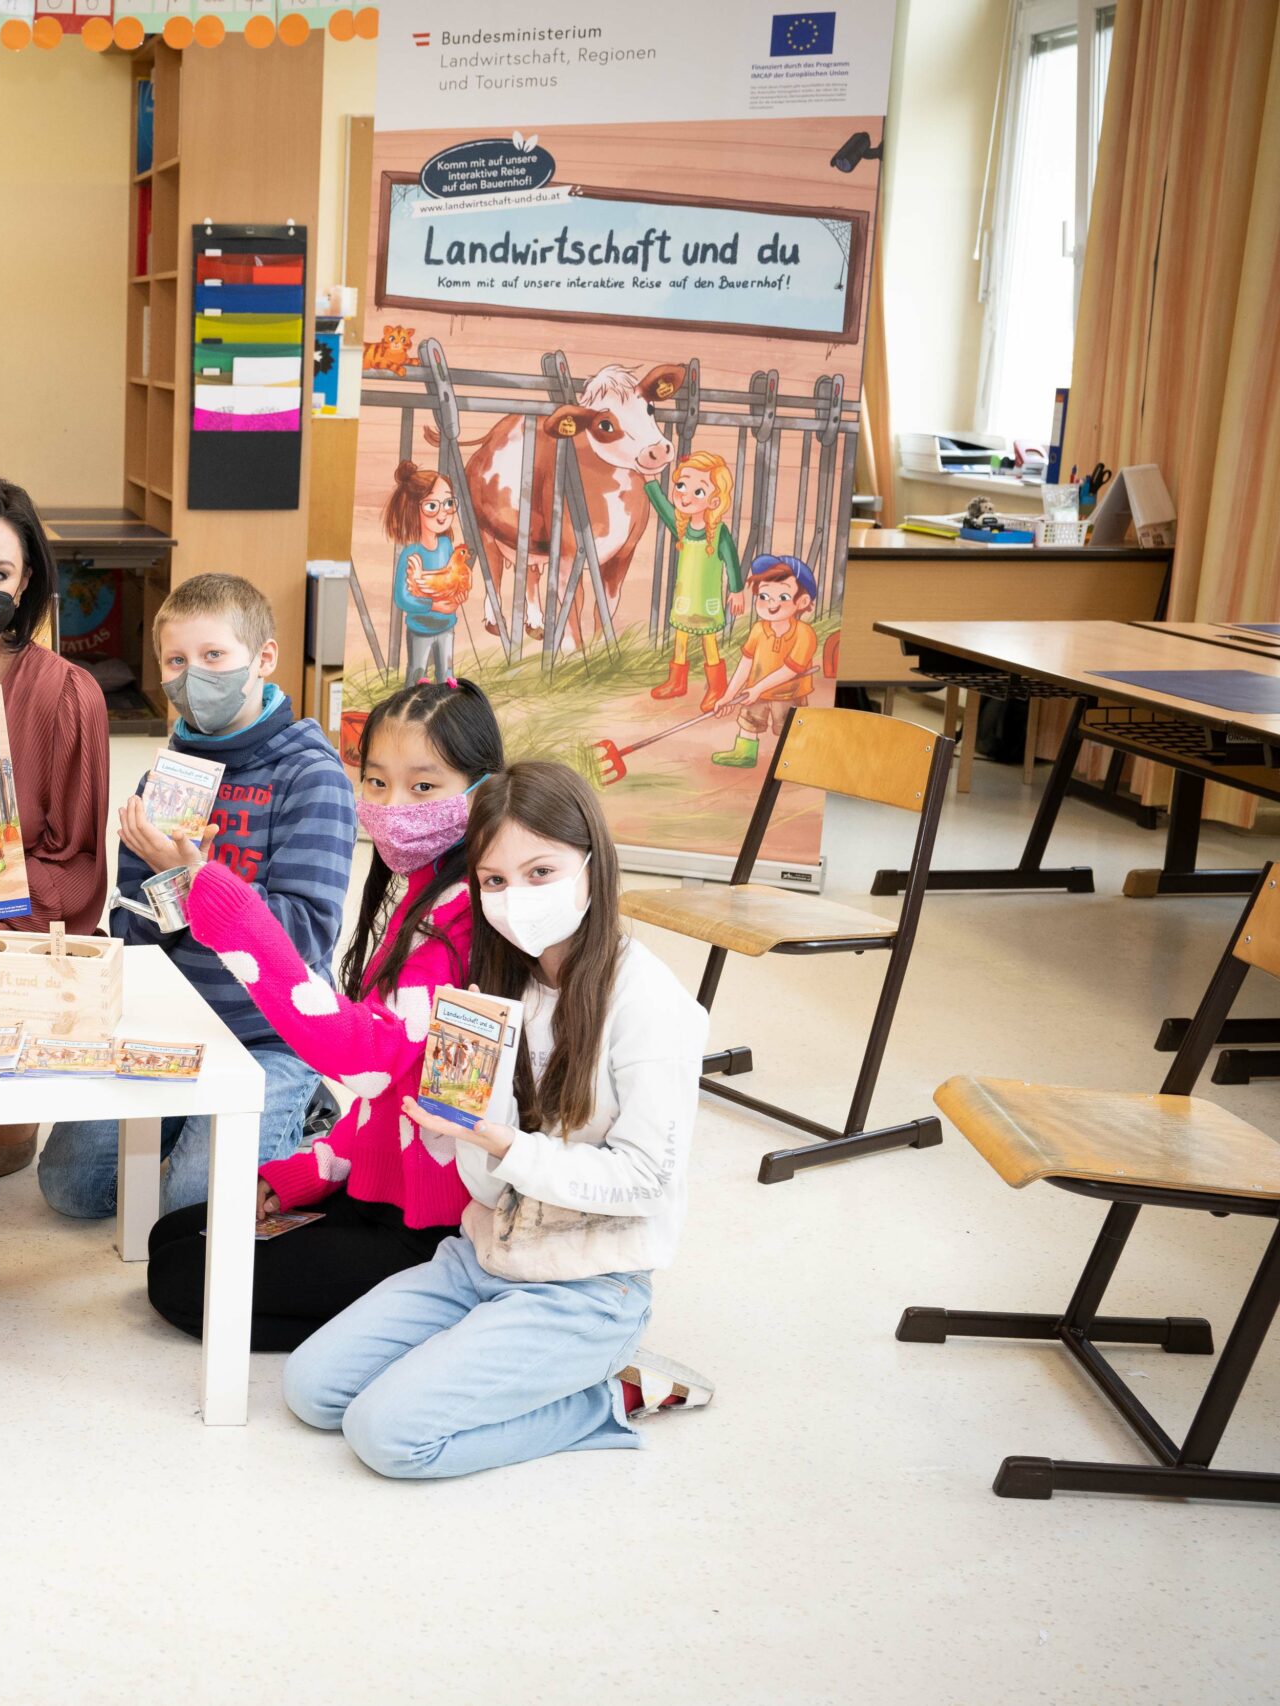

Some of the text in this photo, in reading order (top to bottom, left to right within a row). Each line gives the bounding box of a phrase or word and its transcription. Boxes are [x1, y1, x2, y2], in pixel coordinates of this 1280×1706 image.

[441, 26, 602, 46] Bundesministerium
[440, 46, 657, 68] Landwirtschaft, Regionen
[438, 74, 558, 91] und Tourismus
[437, 154, 538, 171] Komm mit auf unsere
[448, 166, 526, 182] interaktive Reise
[442, 176, 533, 193] auf den Bauernhof!
[419, 192, 561, 214] www.landwirtschaft-und-du.at
[424, 224, 802, 273] Landwirtschaft und du
[436, 274, 792, 291] Komm mit auf unsere interaktive Reise auf den Bauernhof!
[16, 974, 39, 988] und
[45, 976, 62, 989] du
